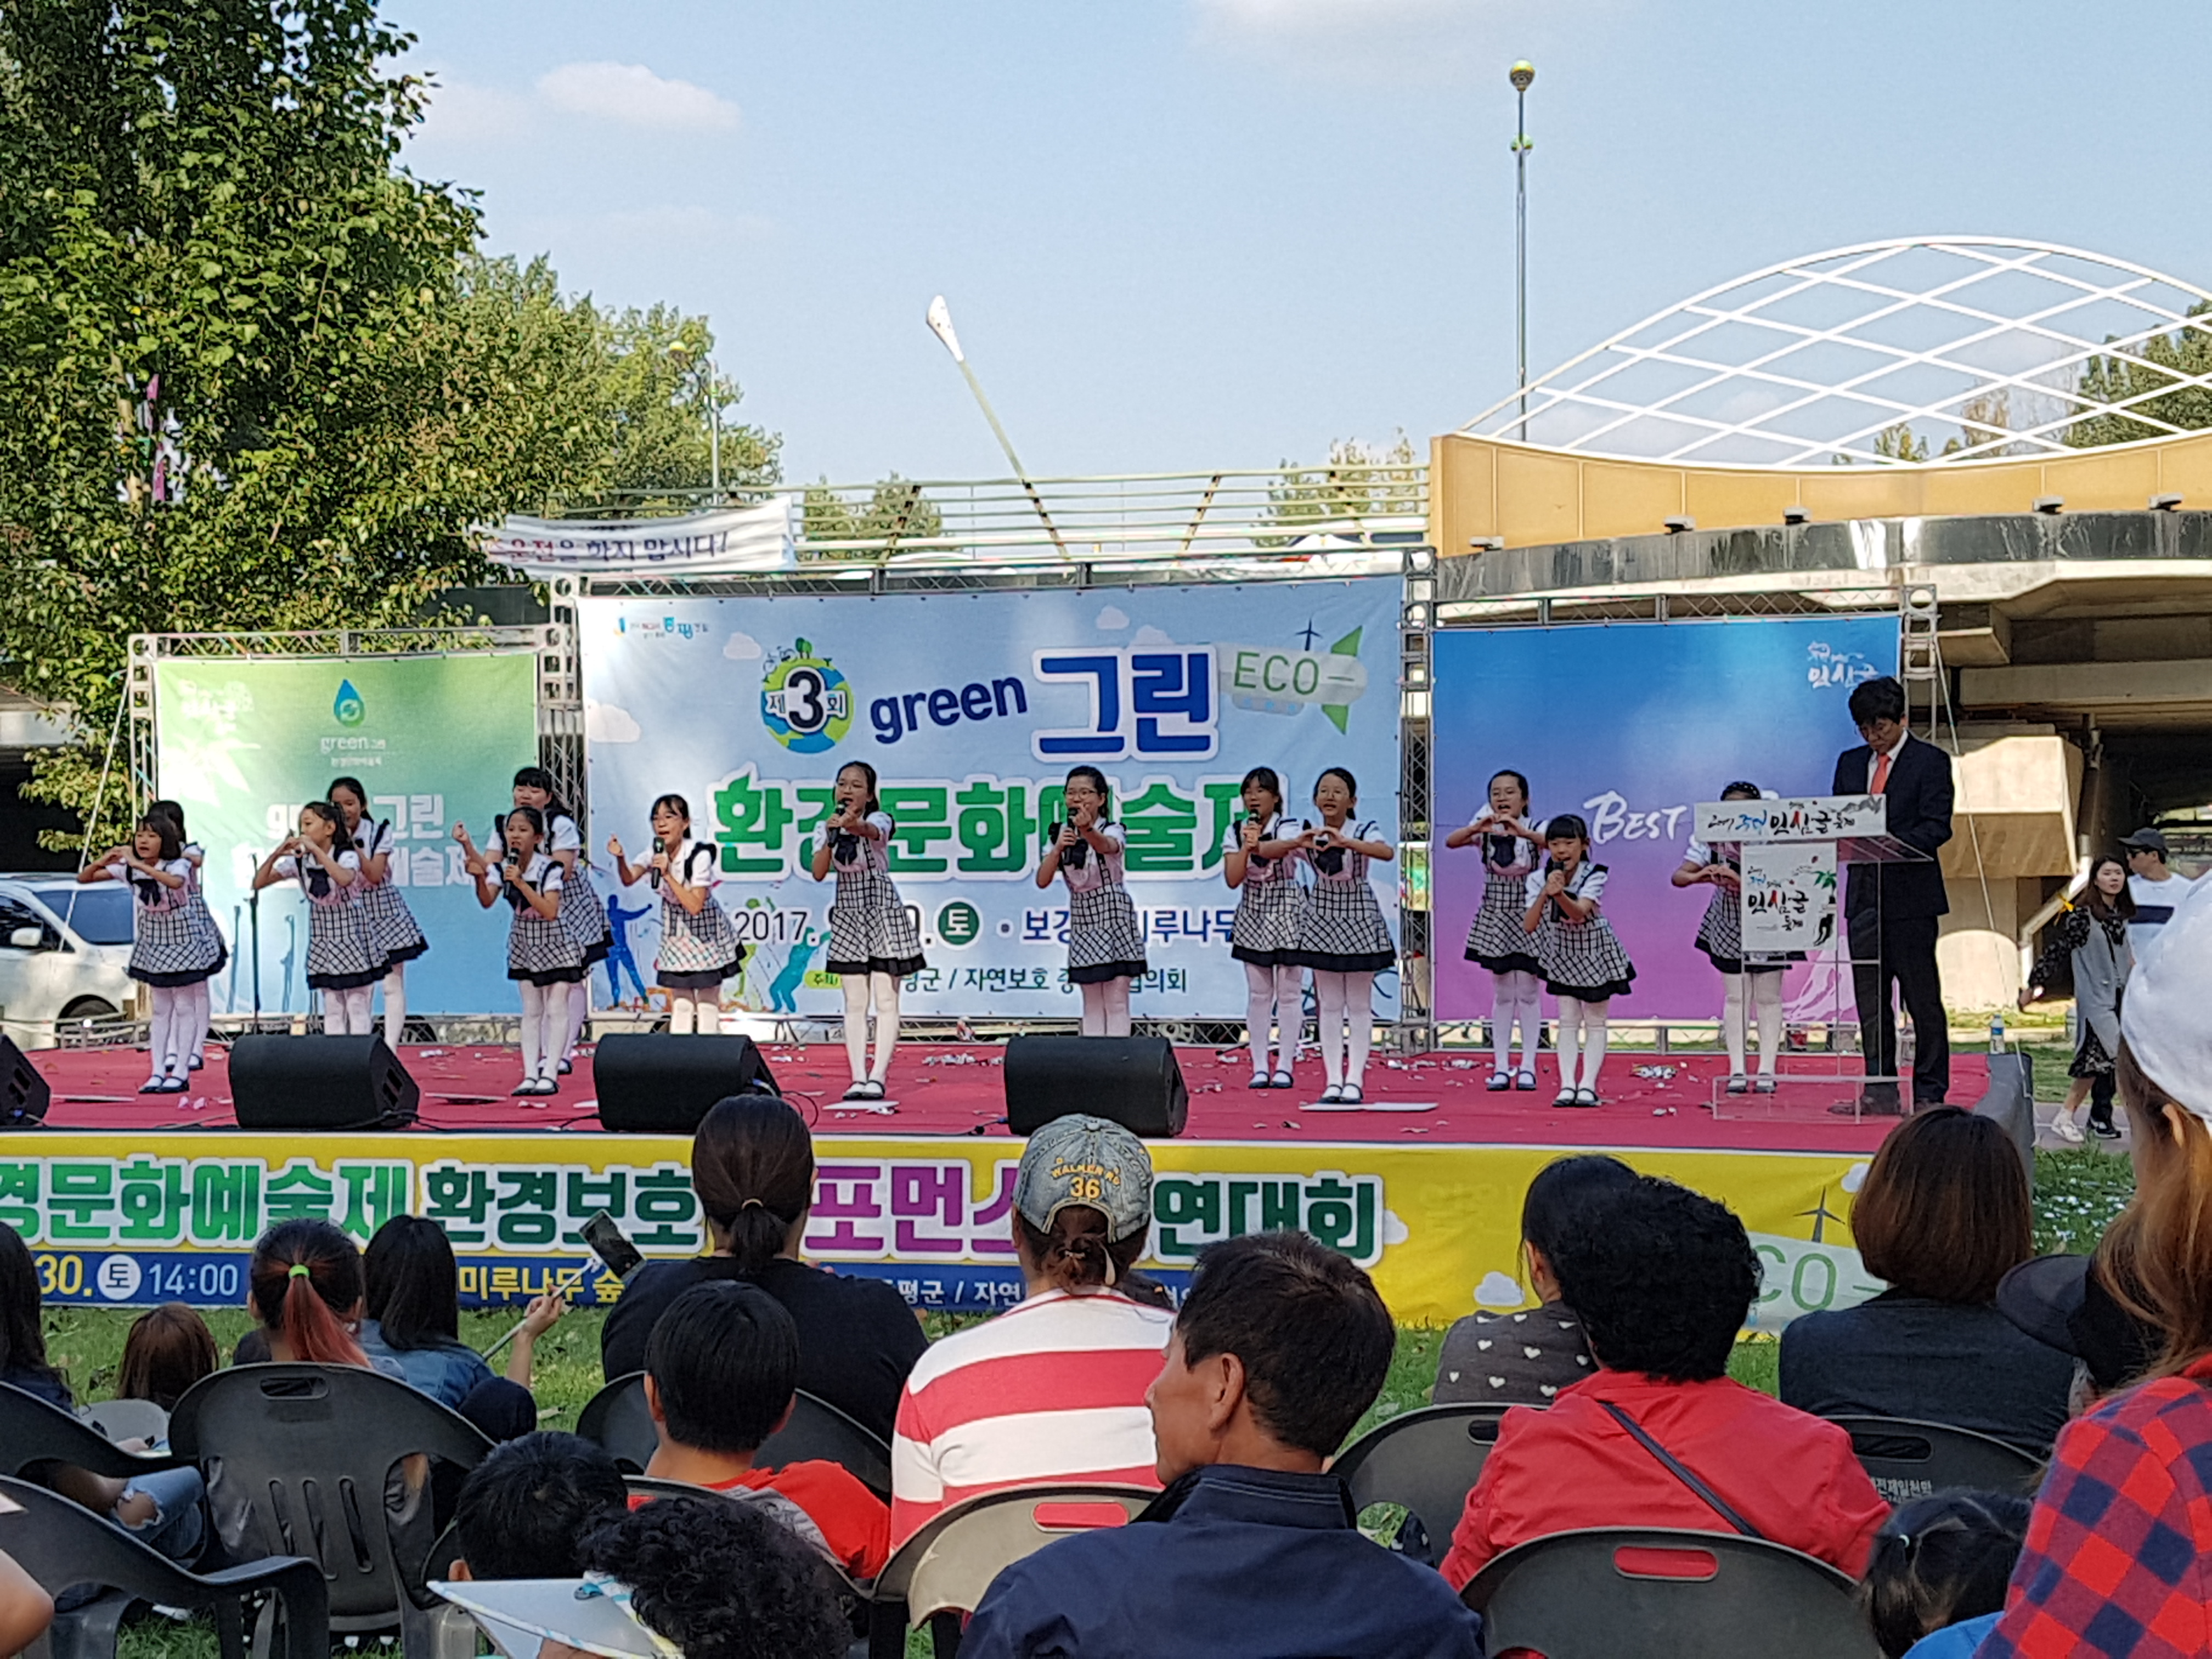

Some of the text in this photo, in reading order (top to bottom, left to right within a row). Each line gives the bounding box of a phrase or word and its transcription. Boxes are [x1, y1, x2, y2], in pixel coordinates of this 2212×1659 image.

[870, 676, 1028, 744] green
[1039, 652, 1211, 753] 그린
[320, 737, 369, 755] green
[1583, 790, 1688, 845] BEST
[964, 968, 1050, 992] 자연보호
[426, 1165, 699, 1244] 환경보호
[1070, 1176, 1102, 1199] 36
[149, 1263, 238, 1296] 14:00
[459, 1266, 585, 1302] 미루나무
[882, 1279, 945, 1305] 평군
